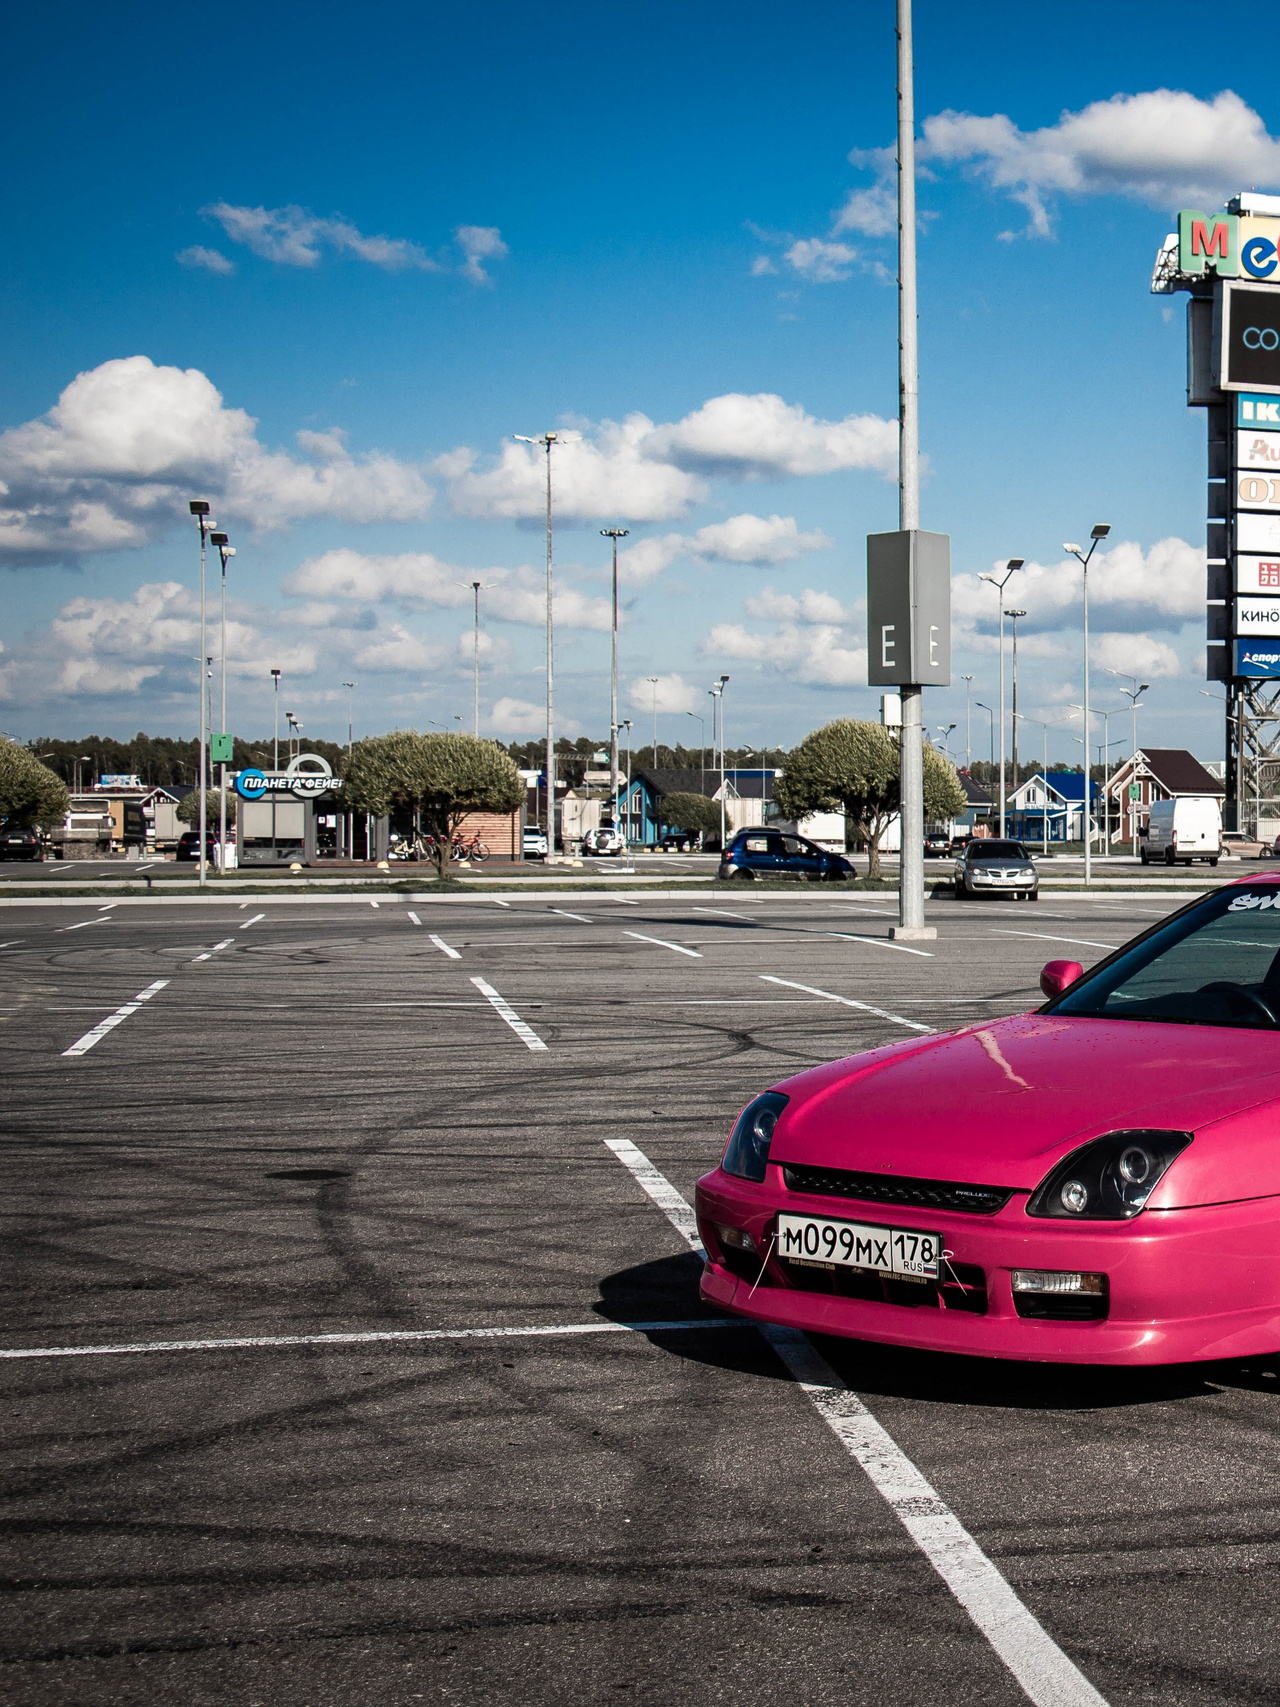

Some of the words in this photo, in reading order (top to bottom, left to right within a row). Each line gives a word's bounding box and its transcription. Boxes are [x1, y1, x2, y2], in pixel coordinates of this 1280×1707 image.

[881, 624, 896, 667] E
[929, 624, 939, 667] E
[243, 777, 302, 789] ПЛАНЕТА
[893, 1233, 933, 1263] 178
[903, 1260, 923, 1273] RUS
